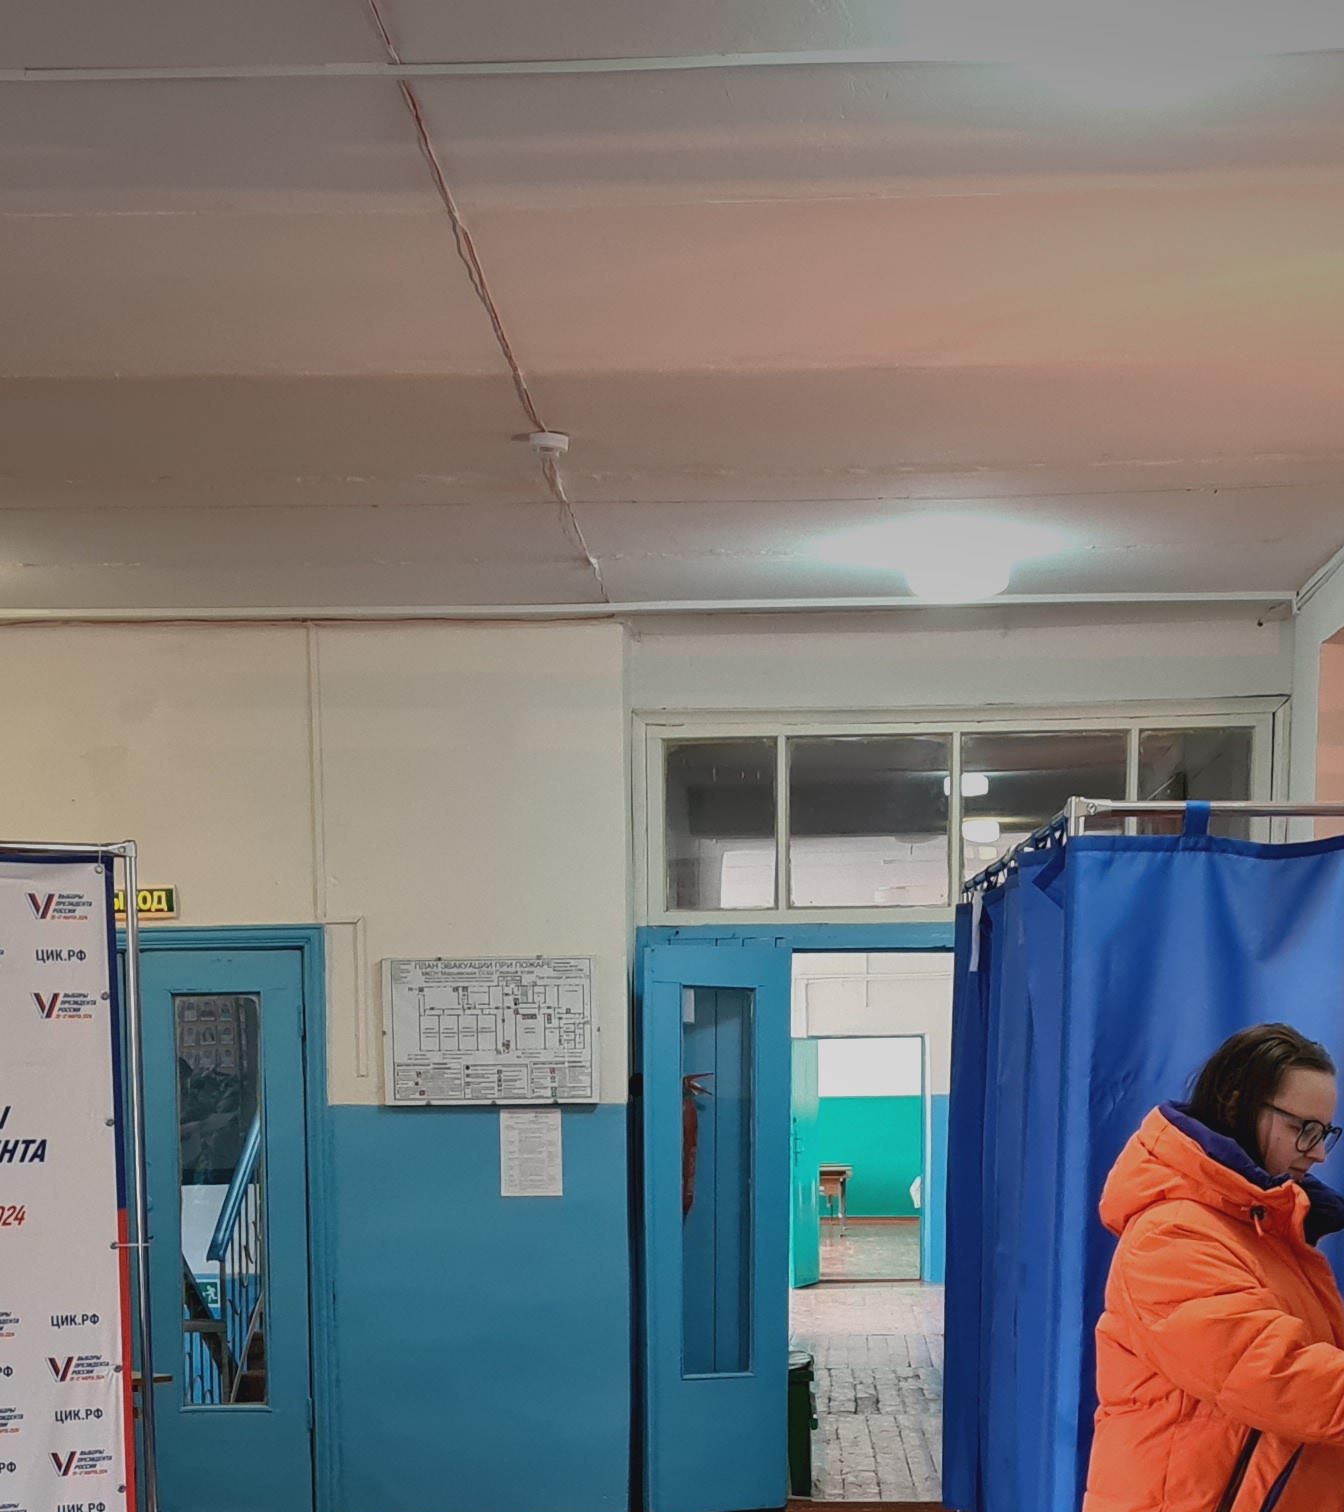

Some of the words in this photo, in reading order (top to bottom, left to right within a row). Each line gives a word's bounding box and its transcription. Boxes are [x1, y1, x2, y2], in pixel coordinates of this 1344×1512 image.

[36, 949, 86, 963] ЦИК.РФ
[51, 1314, 99, 1329] ЦИК.РФ
[55, 1408, 103, 1424] ЦИК.РФ
